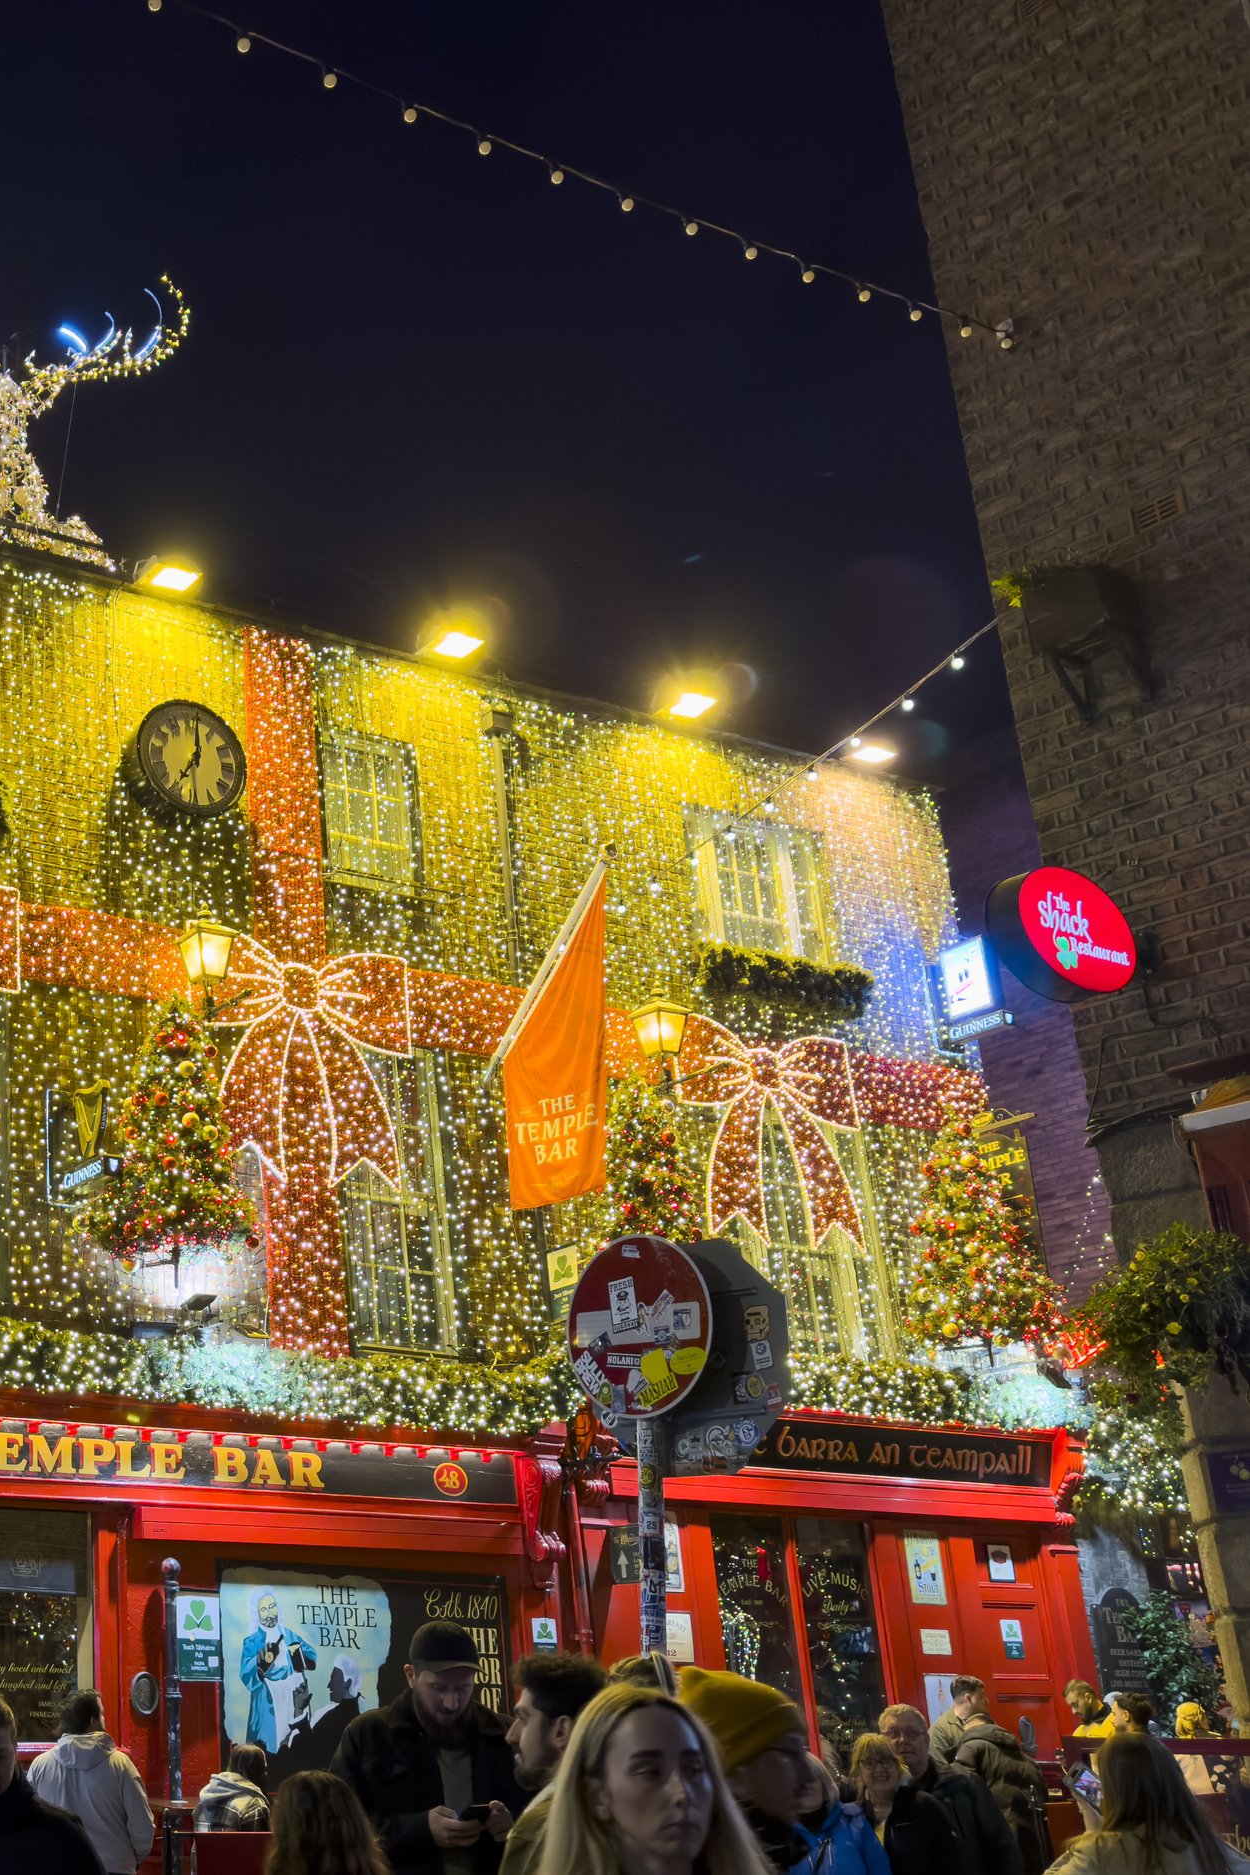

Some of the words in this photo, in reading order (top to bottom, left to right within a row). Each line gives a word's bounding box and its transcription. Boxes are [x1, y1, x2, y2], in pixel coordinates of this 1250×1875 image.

[1052, 893, 1071, 912] The
[1068, 937, 1131, 967] Restaurant
[950, 1013, 1001, 1040] GUINNESS
[538, 1093, 576, 1117] THE
[514, 1102, 599, 1145] TEMPLE
[533, 1137, 578, 1166] BAR
[63, 1159, 102, 1189] GUINNESS
[608, 1278, 634, 1293] FRESH
[612, 1319, 639, 1334] UNSEEN
[573, 1359, 601, 1396] BREW
[580, 1349, 607, 1386] SULLY
[210, 1446, 326, 1490] BAR
[439, 1467, 463, 1490] 48
[741, 1558, 758, 1568] THE
[315, 1584, 358, 1606] THE
[720, 1574, 761, 1598] EMPLE
[765, 1581, 789, 1607] BAR
[801, 1570, 828, 1598] LIVE
[830, 1571, 870, 1601] MUSIC
[918, 1582, 940, 1594] STOUT
[296, 1605, 378, 1629] TEMPLE
[467, 1594, 498, 1621] 1840
[822, 1598, 850, 1615] Daily
[318, 1626, 362, 1651] BAR
[194, 1651, 204, 1659] Pub
[7, 1662, 30, 1674] lived
[30, 1663, 47, 1674] and
[48, 1664, 74, 1675] loved
[0, 1679, 34, 1692] laughed
[34, 1680, 53, 1690] and
